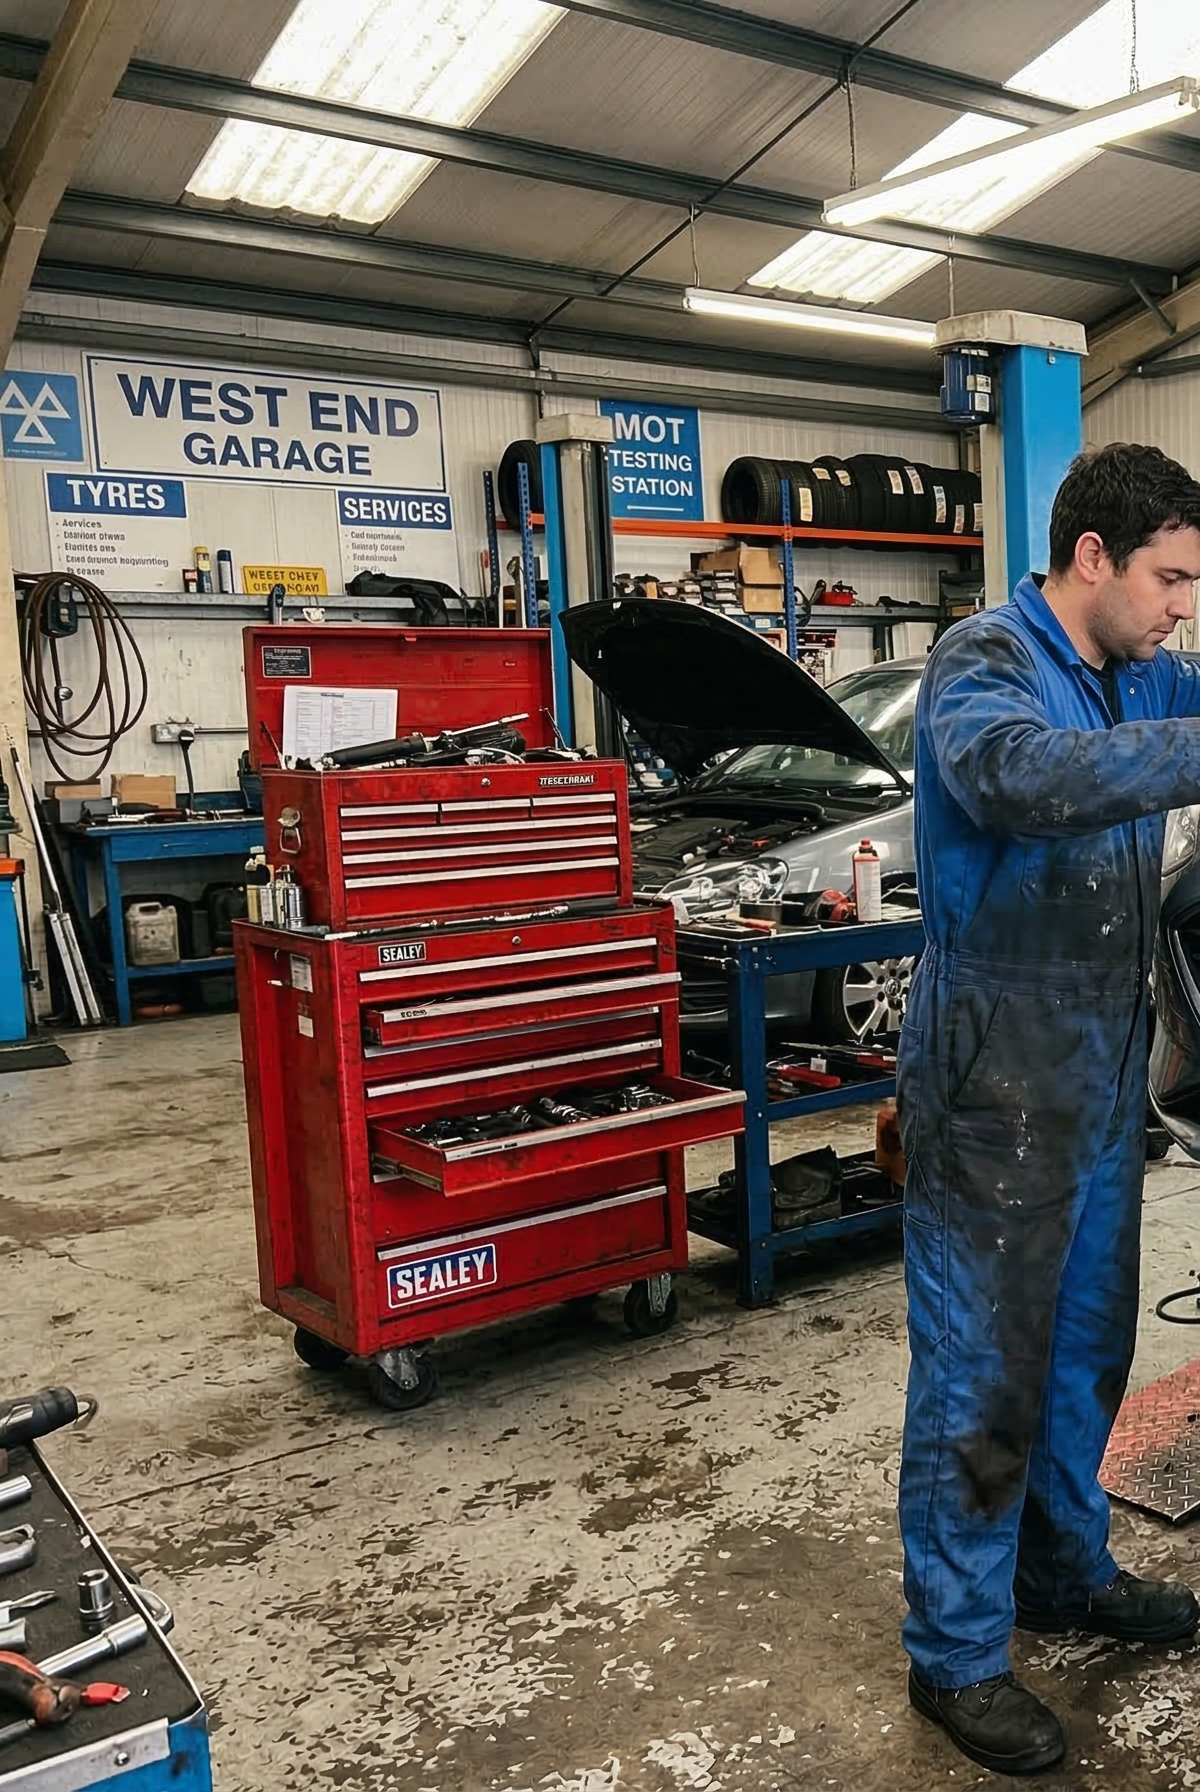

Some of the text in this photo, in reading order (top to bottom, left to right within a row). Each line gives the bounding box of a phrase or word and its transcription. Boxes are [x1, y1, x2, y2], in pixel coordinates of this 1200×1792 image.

[117, 373, 419, 437] WEST END
[615, 412, 685, 445] MOT
[183, 432, 372, 476] GARAGE
[609, 449, 693, 472] TESTING
[66, 479, 166, 510] TYRES
[611, 475, 694, 497] STATION
[343, 497, 447, 523] SERVICES
[382, 944, 422, 962] SEALEY
[395, 1250, 488, 1300] SEALEY
